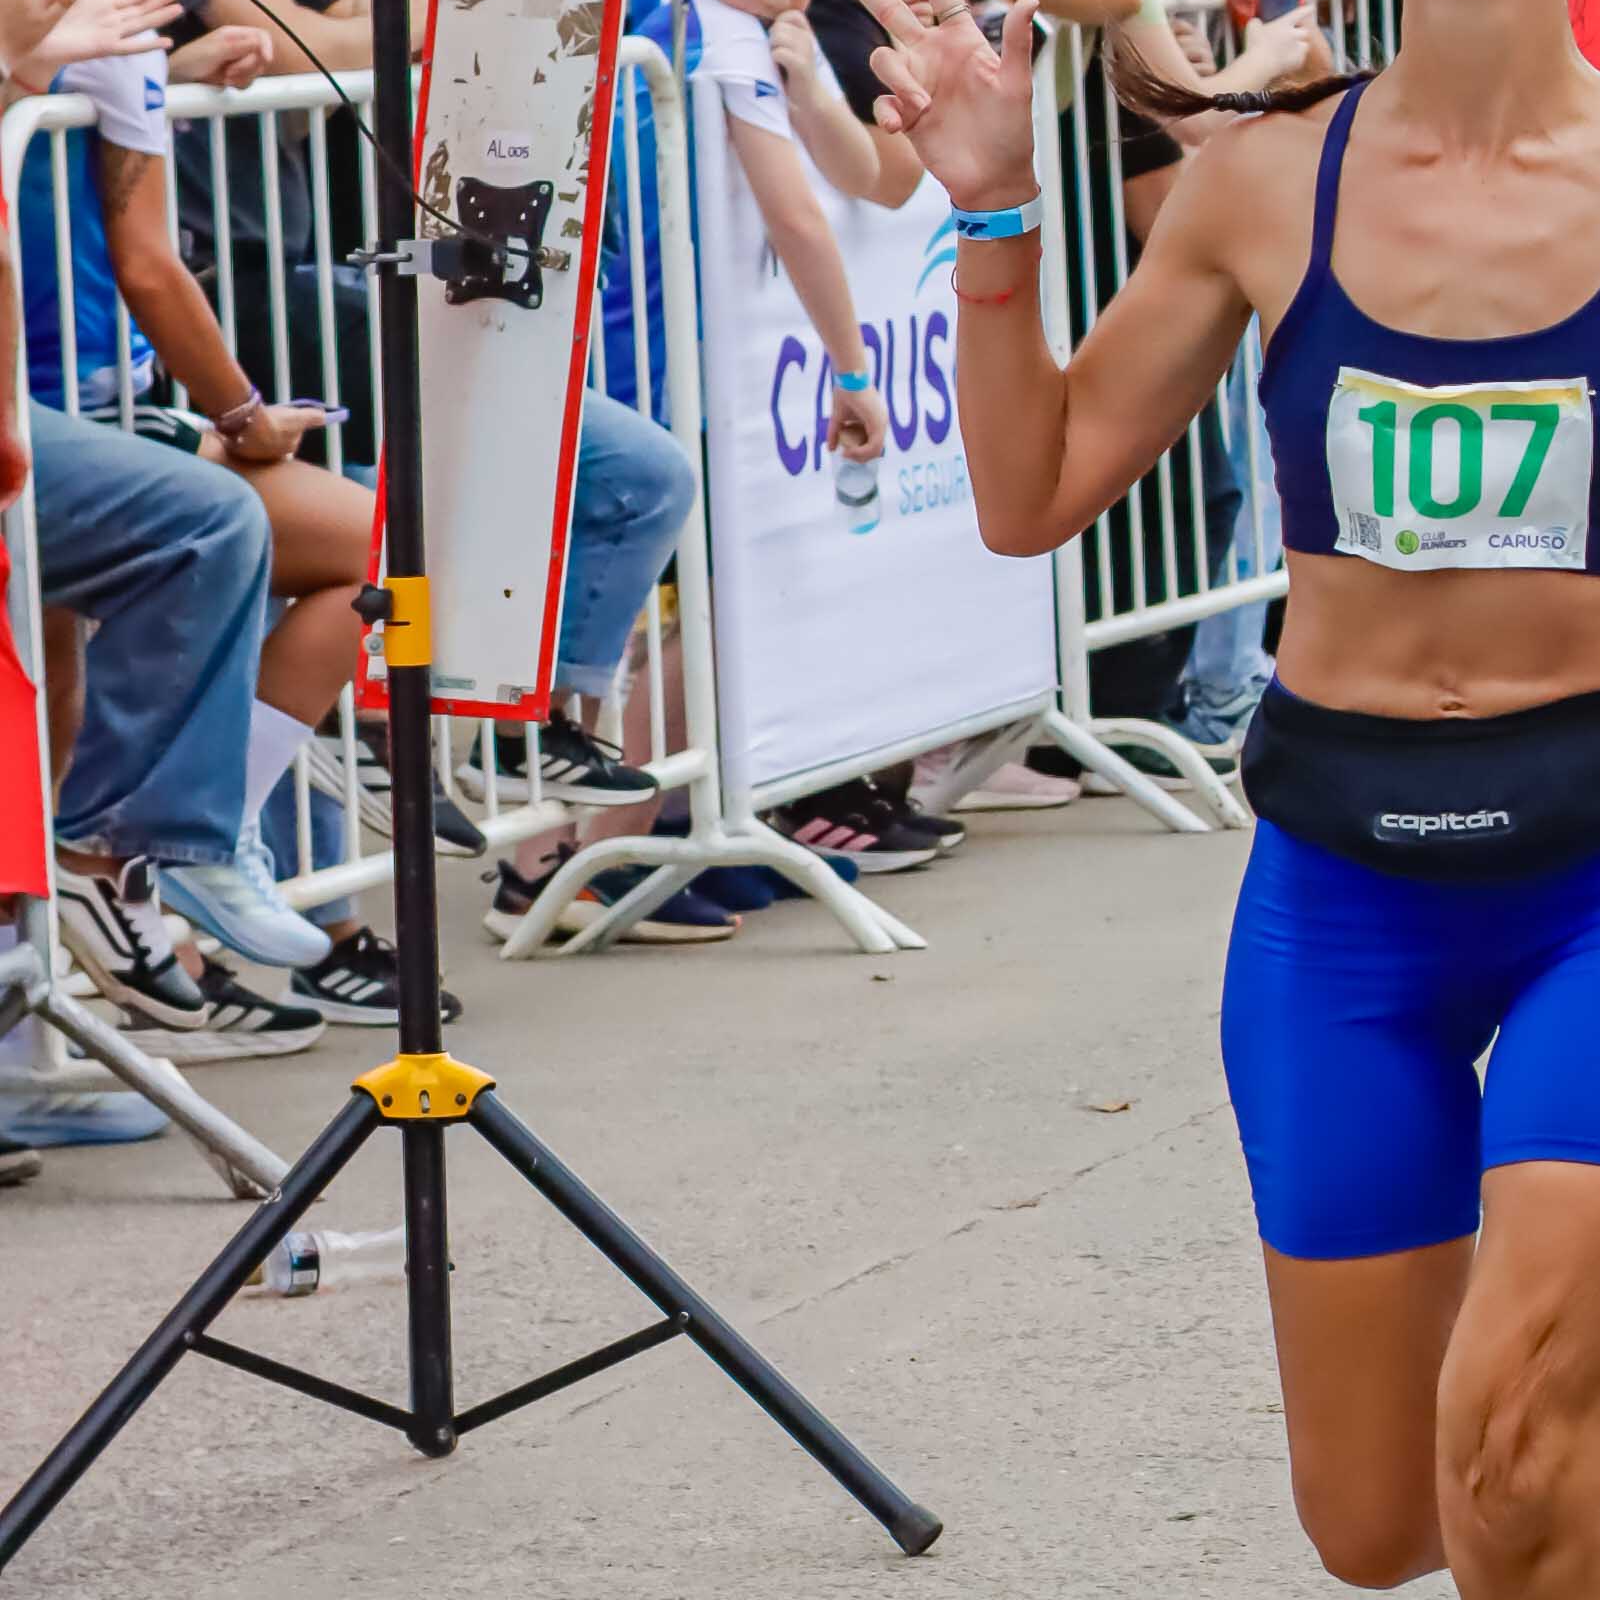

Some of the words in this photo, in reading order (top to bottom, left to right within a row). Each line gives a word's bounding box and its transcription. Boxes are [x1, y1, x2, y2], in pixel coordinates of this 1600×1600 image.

[771, 310, 957, 476] CAUS
[1358, 400, 1560, 520] 107
[1488, 534, 1565, 550] CARUSO
[1381, 810, 1509, 836] capitán
